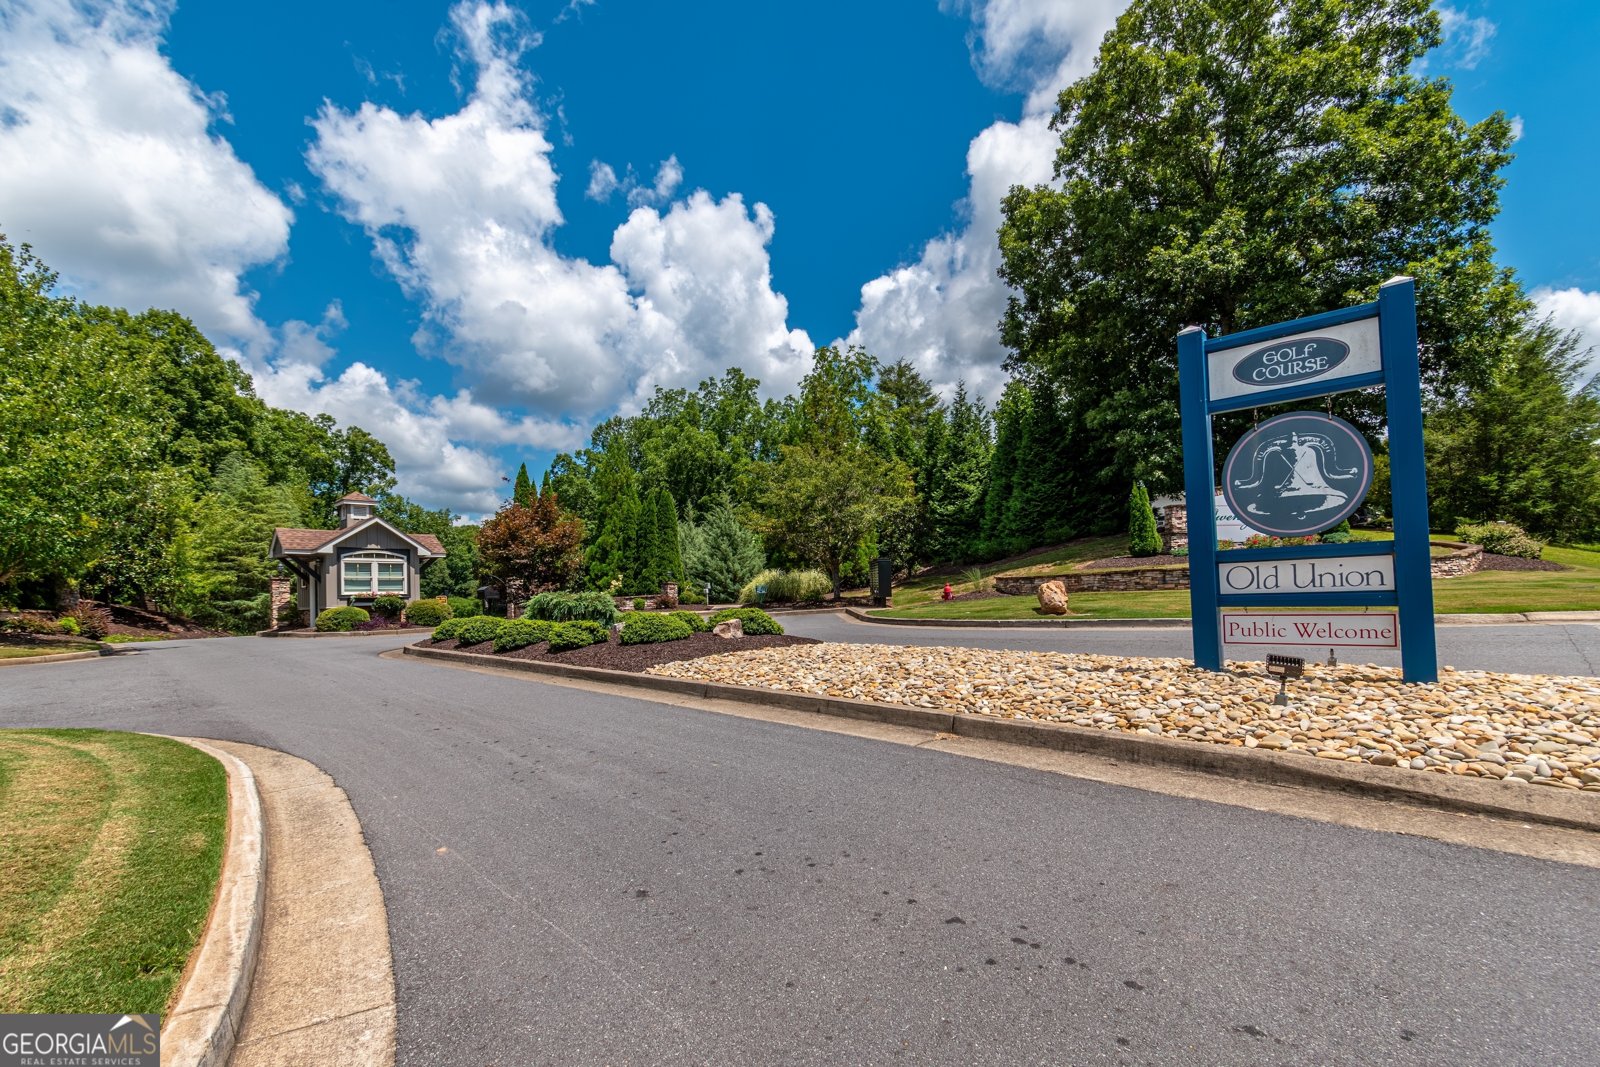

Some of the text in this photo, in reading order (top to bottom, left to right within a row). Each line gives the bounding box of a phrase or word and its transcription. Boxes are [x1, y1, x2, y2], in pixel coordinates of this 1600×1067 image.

[1262, 342, 1317, 365] GOLF
[1252, 356, 1329, 381] COURSE
[1226, 562, 1387, 590] Old Union
[1229, 621, 1392, 639] Public Welcome
